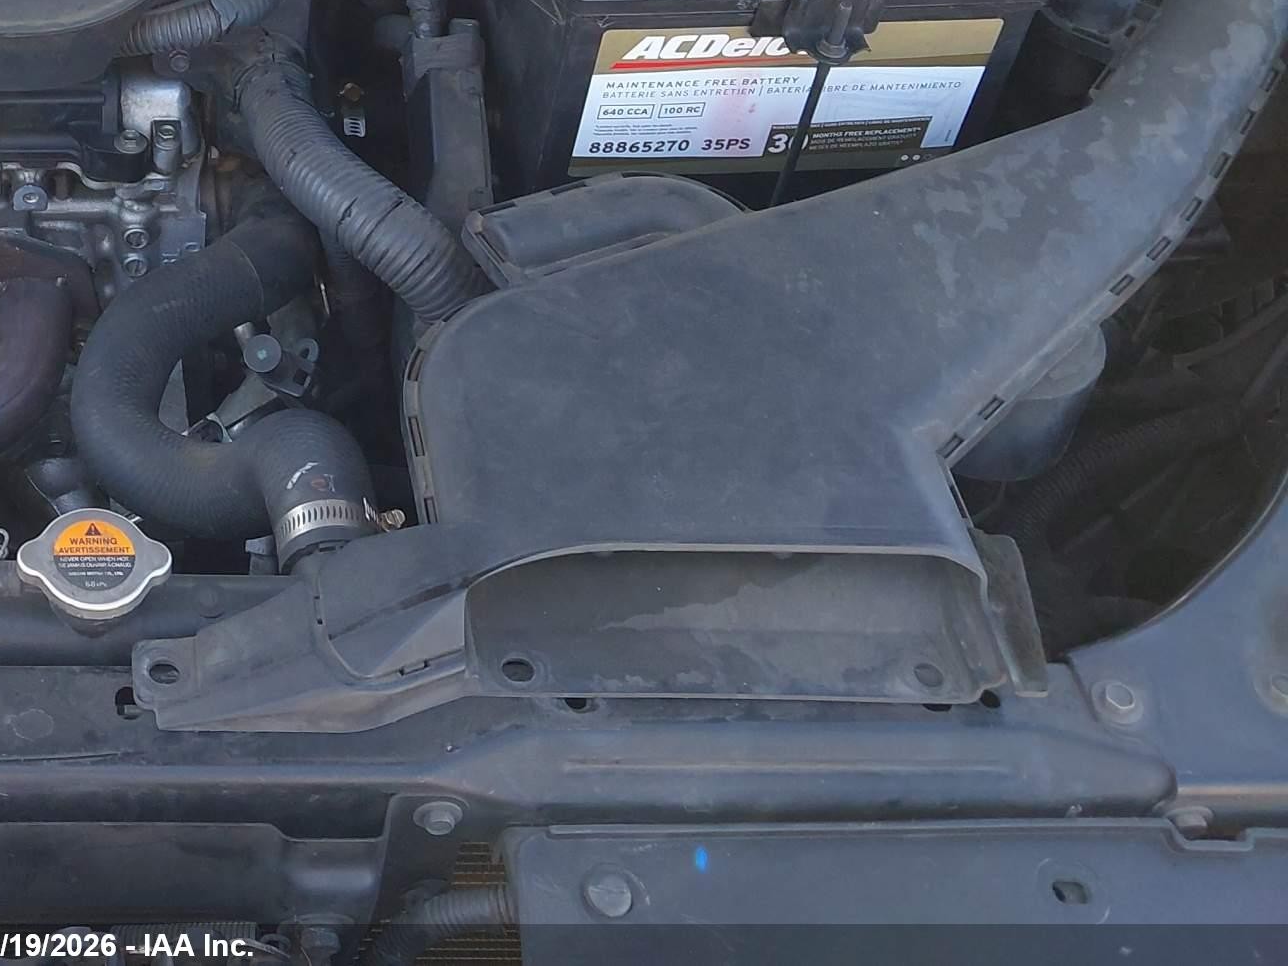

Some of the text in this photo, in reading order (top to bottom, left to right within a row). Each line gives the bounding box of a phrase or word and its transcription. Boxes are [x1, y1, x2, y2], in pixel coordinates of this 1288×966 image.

[622, 34, 807, 60] ACDelc
[606, 76, 800, 89] MAINTENANCE FREE BATTERY
[602, 90, 656, 98] BATTERIE
[661, 89, 690, 97] SANS
[694, 88, 756, 96] ENTRETIEN
[852, 83, 864, 91] DE
[869, 81, 962, 90] MANTENIMIENTO
[602, 107, 648, 116] 640 CCA
[685, 106, 701, 114] RC
[589, 138, 751, 154] 88865270 35PS
[69, 537, 118, 545] WARNING
[58, 546, 130, 554] AVERTISSEMENT
